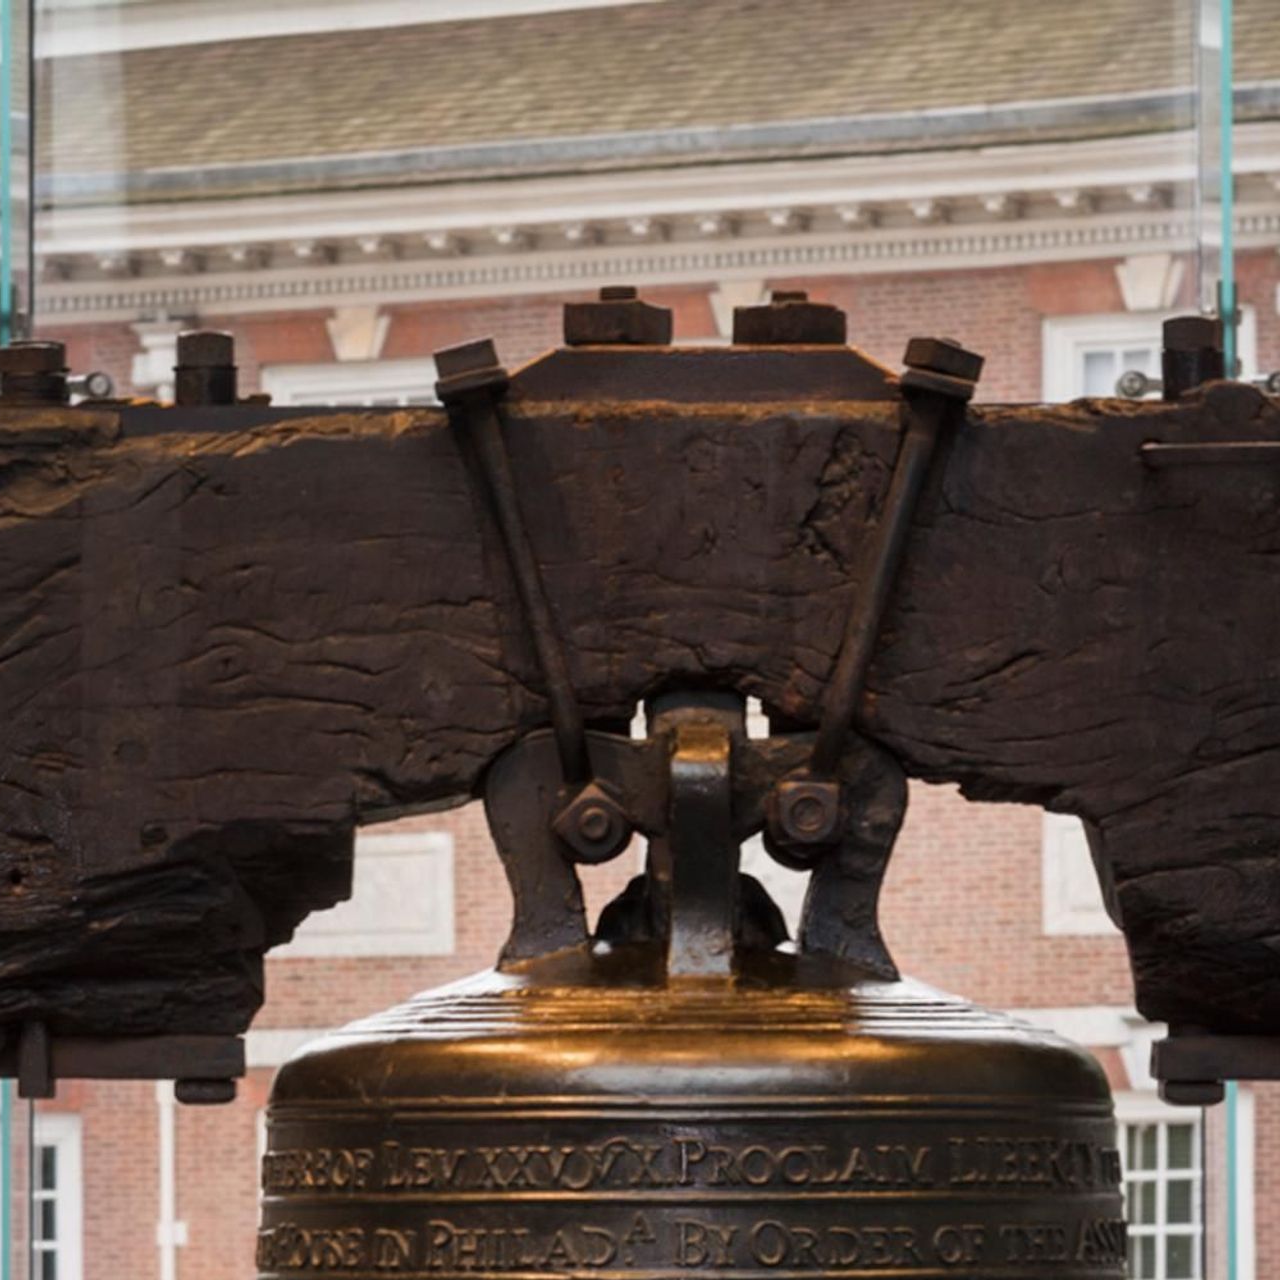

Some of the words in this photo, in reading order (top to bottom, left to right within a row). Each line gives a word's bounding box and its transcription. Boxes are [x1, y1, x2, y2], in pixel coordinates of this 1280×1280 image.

[674, 1138, 933, 1187] PROCLAIM
[675, 1218, 737, 1267] BY
[751, 1219, 919, 1266] ORDER
[933, 1225, 986, 1264] OF
[1000, 1227, 1066, 1264] THE
